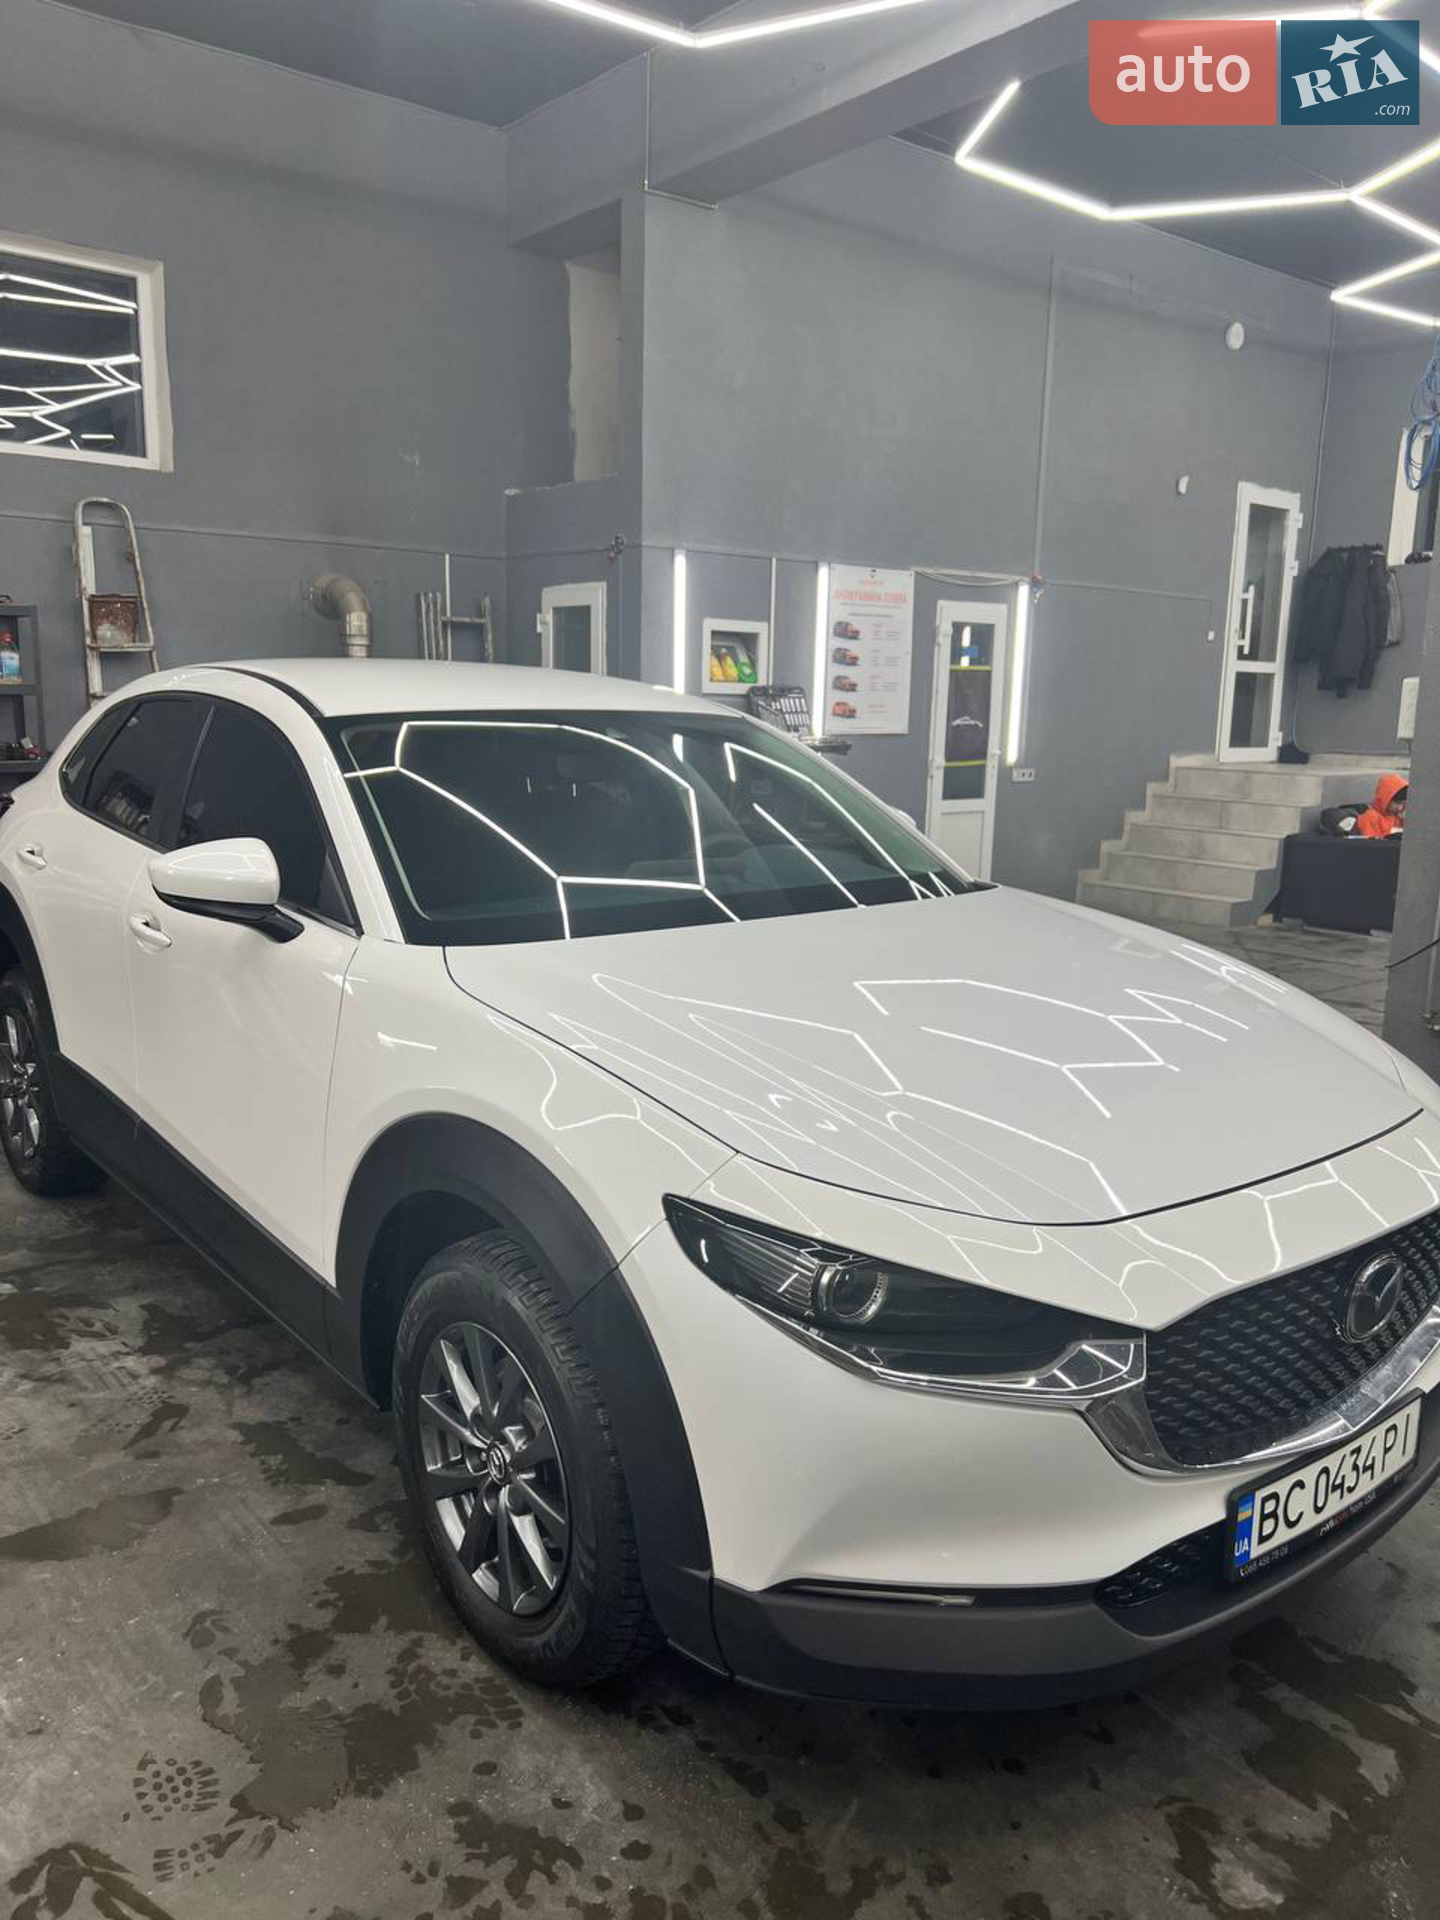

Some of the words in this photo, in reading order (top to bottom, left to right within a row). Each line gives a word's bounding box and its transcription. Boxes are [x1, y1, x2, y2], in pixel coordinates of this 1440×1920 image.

[1257, 1479, 1306, 1545] BC
[1313, 1435, 1376, 1514] 0434
[1381, 1413, 1410, 1473] PI
[1234, 1537, 1249, 1557] UA
